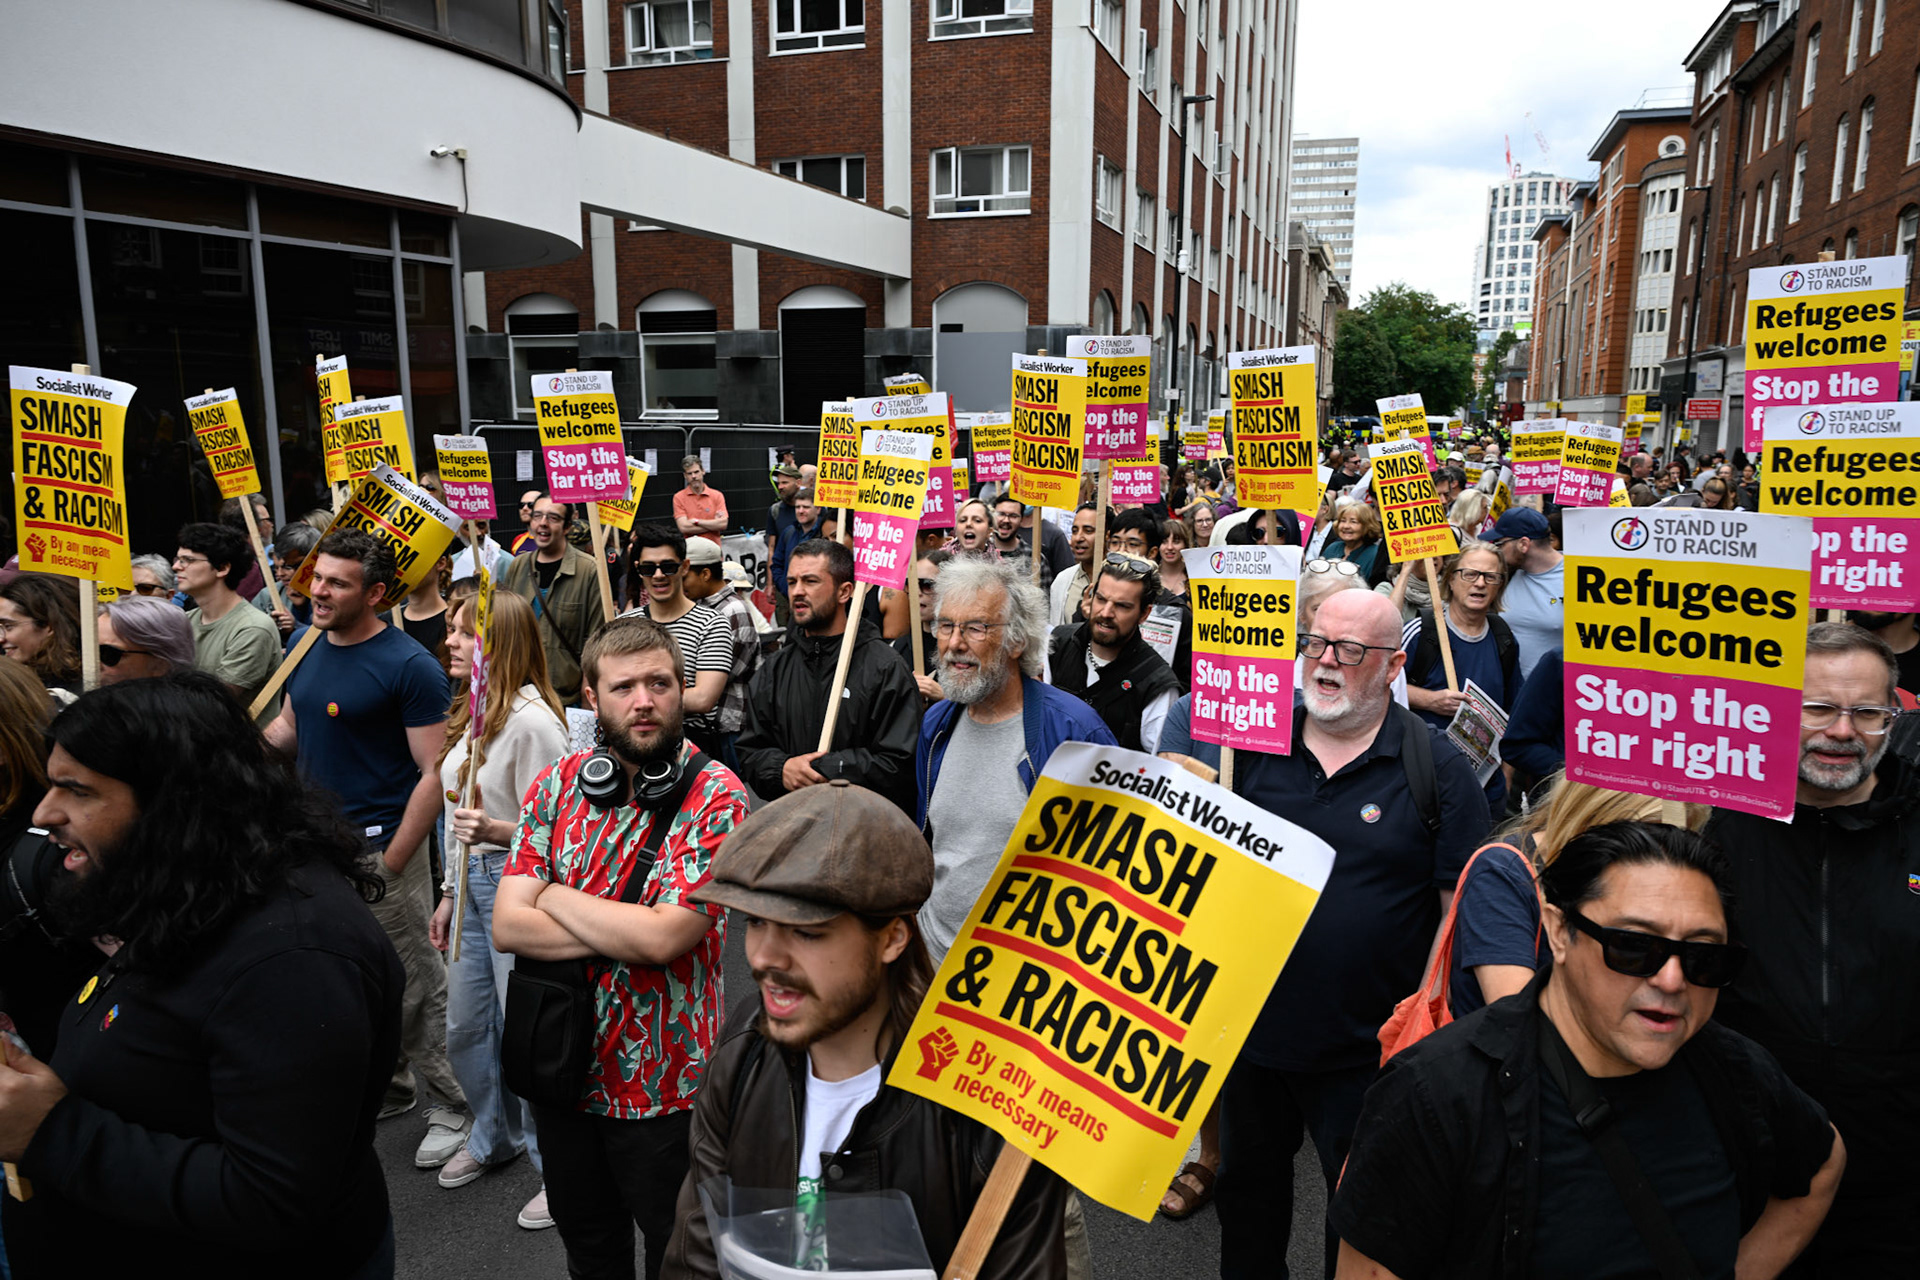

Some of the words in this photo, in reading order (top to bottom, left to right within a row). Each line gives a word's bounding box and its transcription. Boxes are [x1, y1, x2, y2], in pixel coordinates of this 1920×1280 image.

[1807, 266, 1846, 279] STAND
[1849, 265, 1867, 277] UP
[1807, 280, 1822, 291] TO
[1826, 276, 1872, 290] RACISM
[1756, 302, 1896, 331] Refugees
[1100, 340, 1122, 348] STAND
[1101, 347, 1110, 355] TO
[1111, 347, 1135, 355] RACISM
[1755, 332, 1887, 360] welcome
[1044, 362, 1074, 374] Worker
[1241, 356, 1266, 367] Socialist
[1266, 353, 1298, 365] Worker
[564, 376, 587, 384] STAND
[589, 375, 598, 383] UP
[1087, 361, 1147, 382] efugees
[36, 376, 81, 395] Socialist
[82, 383, 112, 400] Worker
[566, 384, 575, 392] TO
[576, 383, 601, 391] RACISM
[1015, 375, 1058, 404] SMASH
[1086, 381, 1142, 398] elcome
[1235, 372, 1283, 400] SMASH
[1752, 375, 1820, 405] Stop
[1828, 371, 1880, 397] the
[364, 403, 390, 414] Worker
[539, 400, 615, 419] Refugees
[831, 405, 853, 413] Socialist
[888, 399, 911, 408] STAND
[913, 398, 924, 406] UP
[889, 407, 898, 416] TO
[900, 406, 928, 415] RACISM
[20, 397, 102, 440] SMASH
[190, 407, 227, 430] SMASH
[1013, 406, 1071, 438] FASCISM
[1111, 408, 1138, 426] the
[1236, 406, 1300, 434] FASCISM
[1384, 411, 1424, 425] Refugees
[1829, 410, 1872, 422] STAND
[1876, 409, 1896, 421] UP
[341, 418, 382, 444] SMASH
[544, 421, 616, 438] welcome
[974, 428, 1012, 438] Refugees
[1829, 423, 1845, 434] TO
[1849, 421, 1901, 434] RACISM
[975, 438, 1011, 448] welcome
[1097, 428, 1137, 449] right
[1381, 443, 1412, 455] Socialist
[1515, 435, 1564, 447] Refugees
[1568, 438, 1617, 456] Refugees
[213, 448, 254, 472] RACISM
[346, 445, 400, 472] FASCISM
[439, 452, 487, 467] Refugees
[548, 450, 587, 471] Stop
[591, 447, 619, 465] the
[976, 453, 995, 464] Stop
[995, 452, 1011, 462] the
[1021, 441, 1079, 472] RACISM
[1237, 442, 1247, 467] &
[1250, 440, 1313, 468] RACISM
[1515, 448, 1561, 458] welcome
[1566, 453, 1613, 469] welcome
[1771, 446, 1920, 479] Refugees
[22, 442, 113, 489] FASCISM
[441, 467, 487, 478] welcome
[819, 462, 828, 480] &
[977, 465, 989, 474] far
[991, 463, 1011, 476] right
[1133, 469, 1153, 481] the
[1376, 455, 1426, 480] SMASH
[1514, 464, 1540, 476] Stop
[1541, 462, 1560, 473] the
[551, 471, 575, 489] far
[580, 469, 622, 490] right
[862, 460, 925, 496] Refugees
[1036, 480, 1062, 491] means
[1269, 480, 1295, 490] means
[1515, 477, 1529, 488] far
[1532, 474, 1558, 488] right
[1561, 470, 1590, 487] Stop
[1591, 472, 1608, 487] the
[384, 474, 420, 503] Socialist
[419, 498, 449, 523] Worker
[443, 483, 466, 499] Stop
[468, 484, 488, 497] the
[858, 485, 915, 510] welcome
[1125, 483, 1153, 497] right
[1250, 491, 1282, 504] necessary
[1380, 480, 1439, 506] FASCISM
[1559, 483, 1578, 497] far
[1579, 485, 1605, 502] right
[1770, 480, 1917, 506] welcome
[24, 486, 45, 519] &
[54, 489, 123, 536] RACISM
[357, 481, 425, 537] SMASH
[461, 498, 490, 512] right
[853, 516, 874, 543] Stop
[878, 520, 904, 544] the
[1386, 511, 1399, 531] &
[1654, 519, 1715, 536] STAND
[1721, 522, 1748, 538] UP
[50, 535, 63, 553] By
[66, 541, 79, 556] any
[83, 544, 111, 559] means
[1403, 537, 1410, 547] By
[1413, 537, 1425, 546] any
[1426, 534, 1446, 543] means
[1405, 543, 1438, 556] necessary
[1654, 537, 1677, 553] TO
[1683, 538, 1757, 558] RACISM
[1850, 525, 1908, 553] the
[51, 554, 98, 575] necessary
[859, 543, 897, 570] right
[1226, 551, 1251, 563] STAND
[1254, 552, 1267, 562] UP
[1226, 563, 1234, 574] TO
[1235, 563, 1271, 575] RACISM
[1820, 559, 1904, 593] right
[1197, 584, 1291, 618] Refugees
[1577, 565, 1797, 620] Refugees
[1197, 617, 1285, 647] welcome
[1575, 617, 1783, 668] welcome
[1196, 659, 1232, 695] Stop
[1237, 664, 1279, 694] the
[1195, 691, 1219, 720] far
[1220, 696, 1276, 731] right
[1575, 674, 1677, 729] Stop
[1690, 688, 1771, 733] the
[1575, 719, 1639, 761] far
[1652, 731, 1766, 782] right
[1090, 760, 1190, 818] Socialist
[1190, 795, 1284, 862] Worker
[1024, 795, 1218, 918] SMASH
[980, 871, 1219, 1025] FASCISM
[945, 945, 994, 1007] &
[999, 961, 1212, 1122] RACISM
[965, 1039, 997, 1076] By
[999, 1061, 1037, 1099] any
[1037, 1086, 1108, 1143] means
[953, 1072, 1059, 1150] necessary
